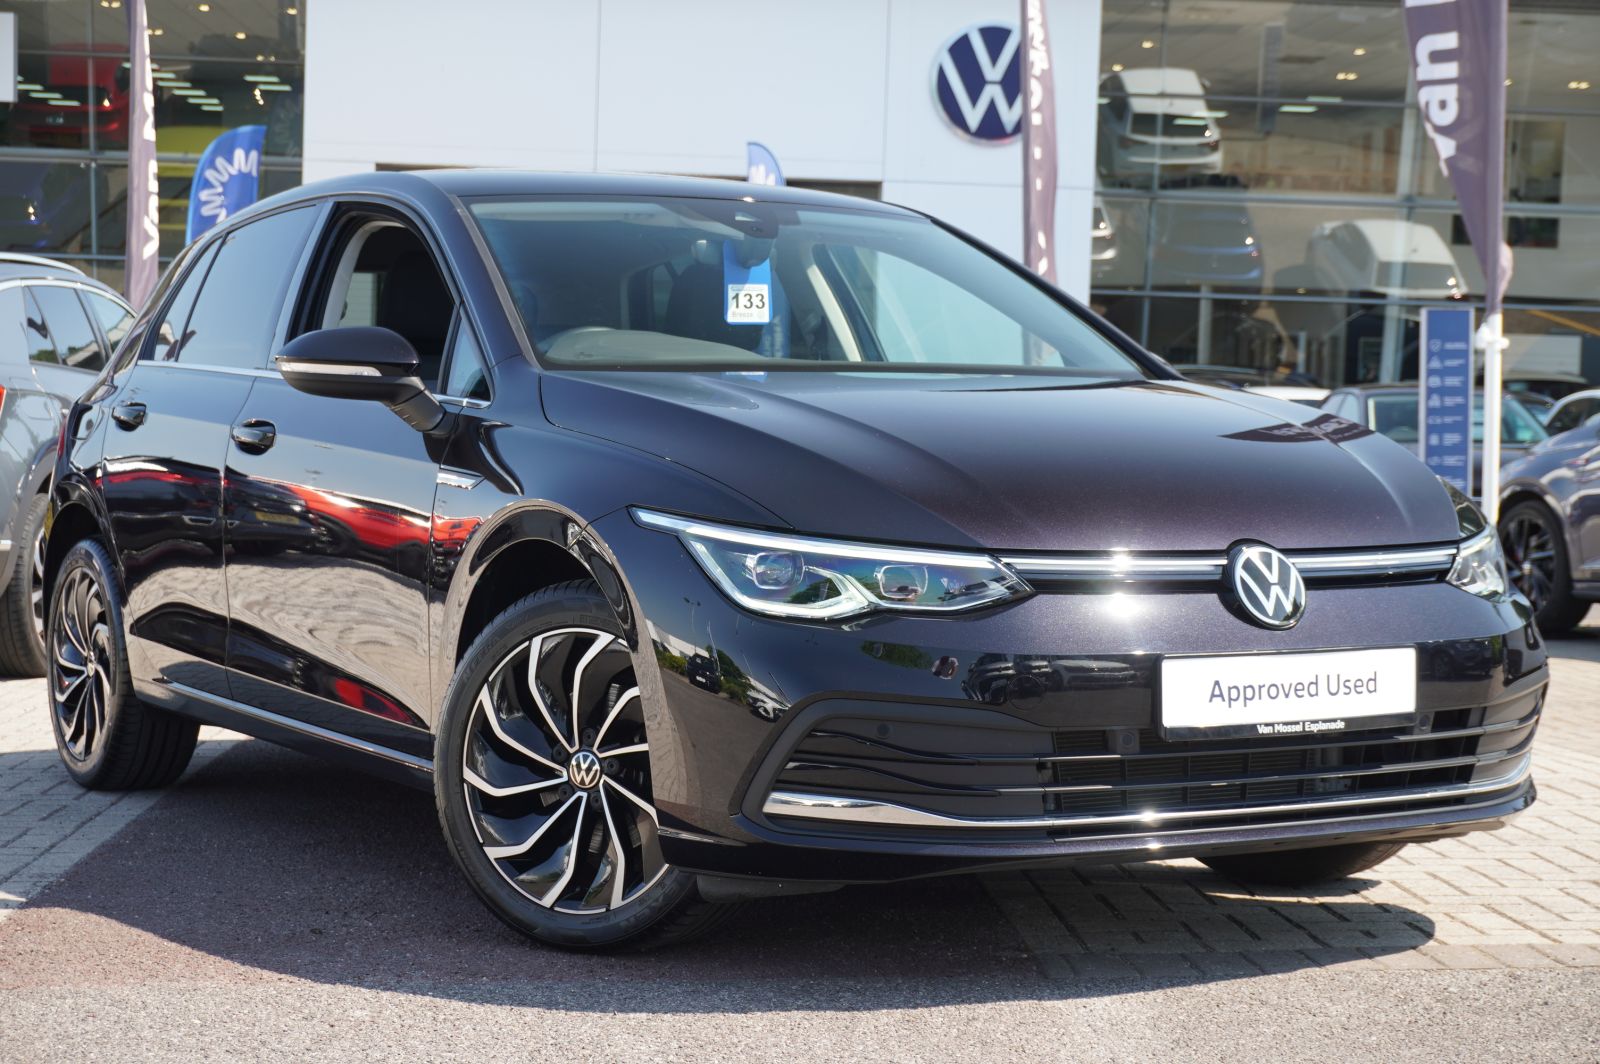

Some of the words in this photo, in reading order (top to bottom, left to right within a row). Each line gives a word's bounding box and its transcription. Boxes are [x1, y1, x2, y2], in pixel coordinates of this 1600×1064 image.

[731, 293, 765, 309] 133
[1236, 547, 1304, 622] VW
[1208, 674, 1319, 708] Approved
[1326, 671, 1378, 696] Used
[1256, 724, 1273, 734] Van
[1274, 722, 1303, 733] Mossel
[1305, 720, 1345, 733] Esplanade
[571, 753, 599, 788] VW
